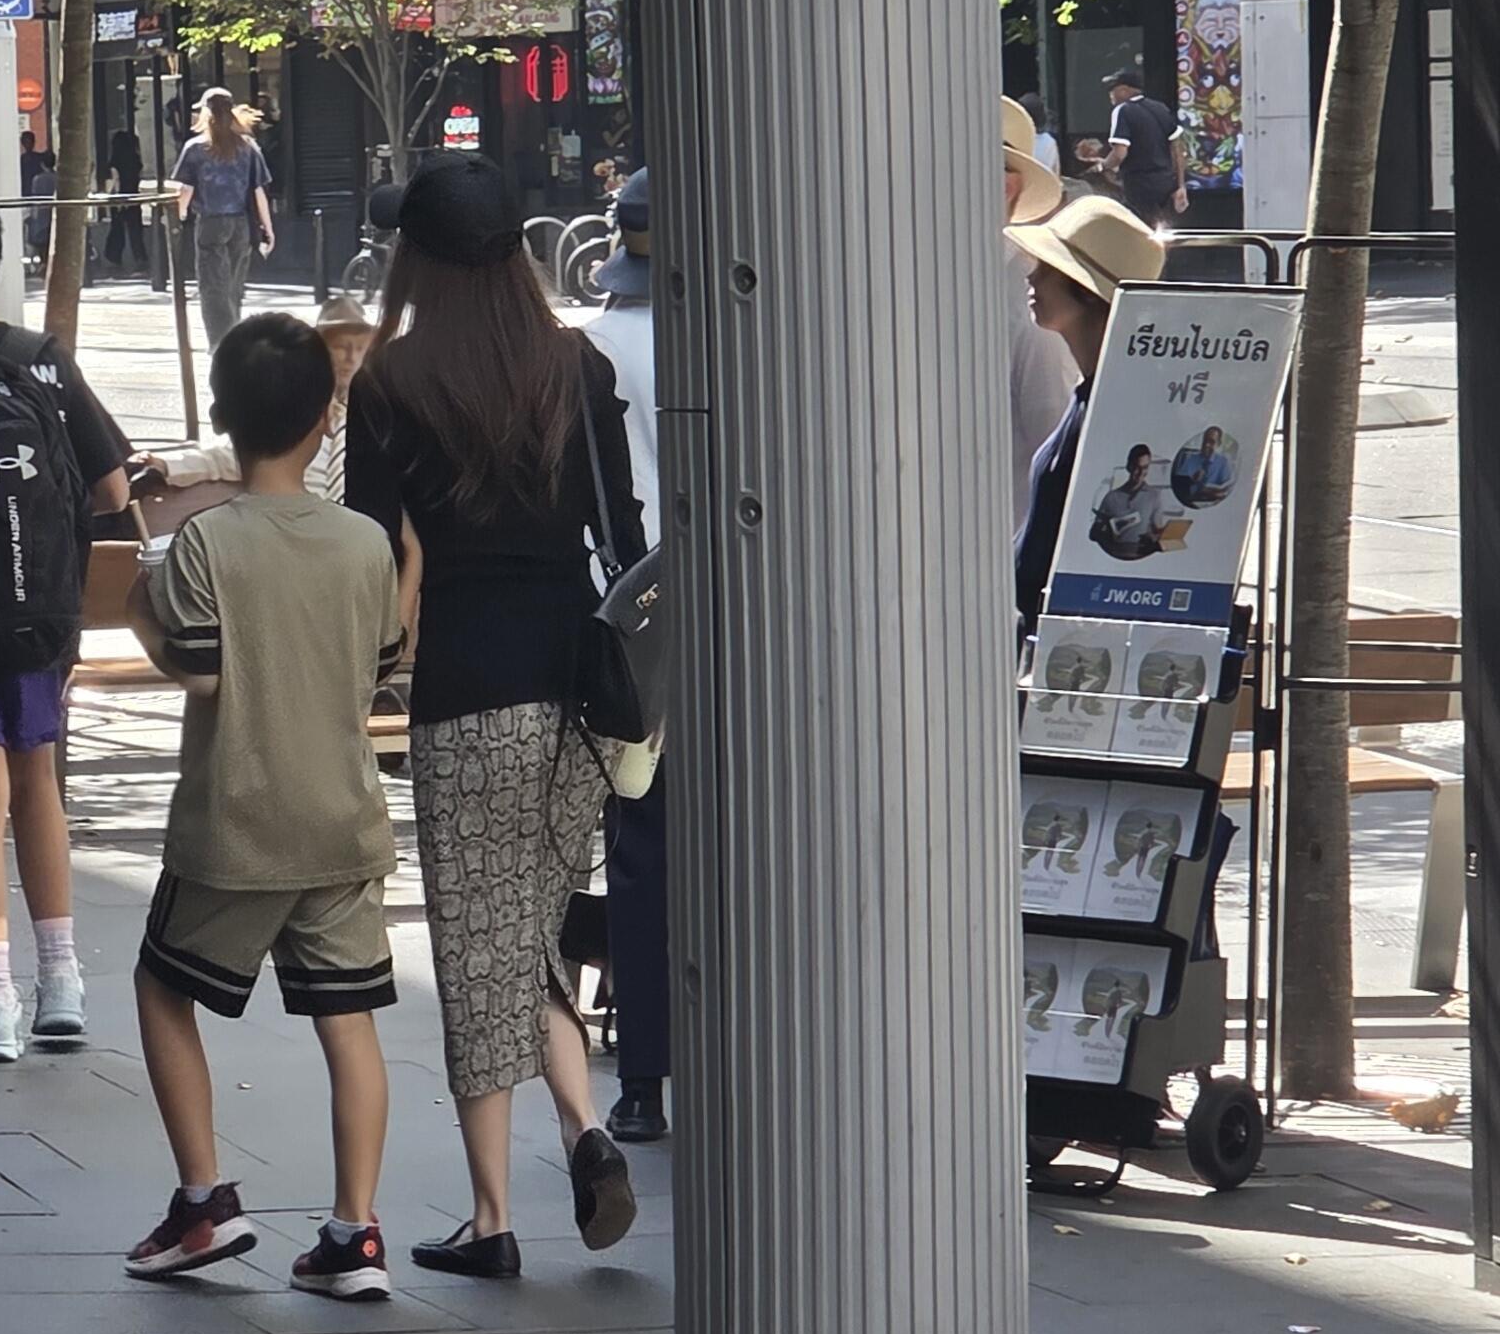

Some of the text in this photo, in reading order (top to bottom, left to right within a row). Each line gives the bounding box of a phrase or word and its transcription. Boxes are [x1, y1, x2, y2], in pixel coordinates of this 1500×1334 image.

[1126, 323, 1271, 362] เรียนไบเบิล
[1167, 370, 1210, 404] ฟรี
[7, 495, 26, 603] UNDER ARMOUR
[1103, 588, 1163, 606] JW.ORG
